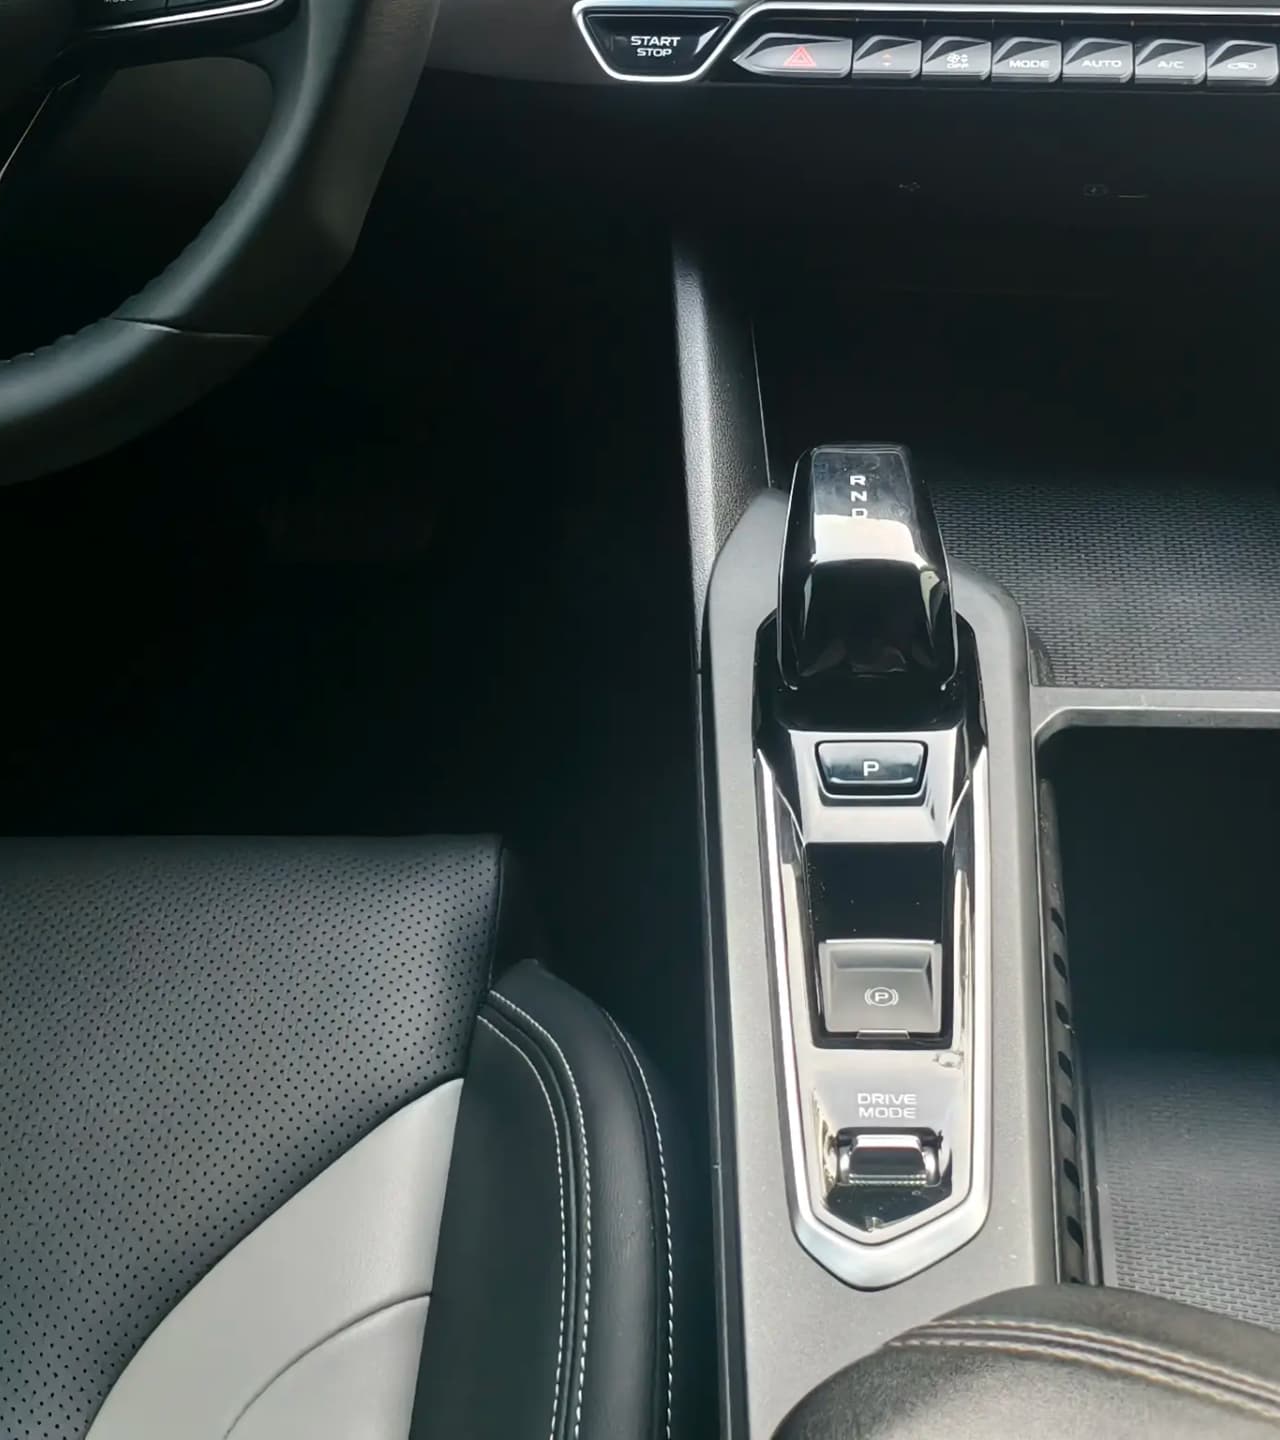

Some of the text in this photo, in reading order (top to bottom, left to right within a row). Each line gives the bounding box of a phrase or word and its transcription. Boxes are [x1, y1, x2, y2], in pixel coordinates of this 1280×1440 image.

[630, 35, 681, 47] START
[637, 47, 672, 58] STOP
[1009, 60, 1050, 69] MODE
[1081, 59, 1122, 68] AUTO
[1157, 60, 1185, 69] A/C
[863, 760, 880, 777] P
[857, 1093, 917, 1105] DRIVE
[858, 1107, 917, 1119] MODE
